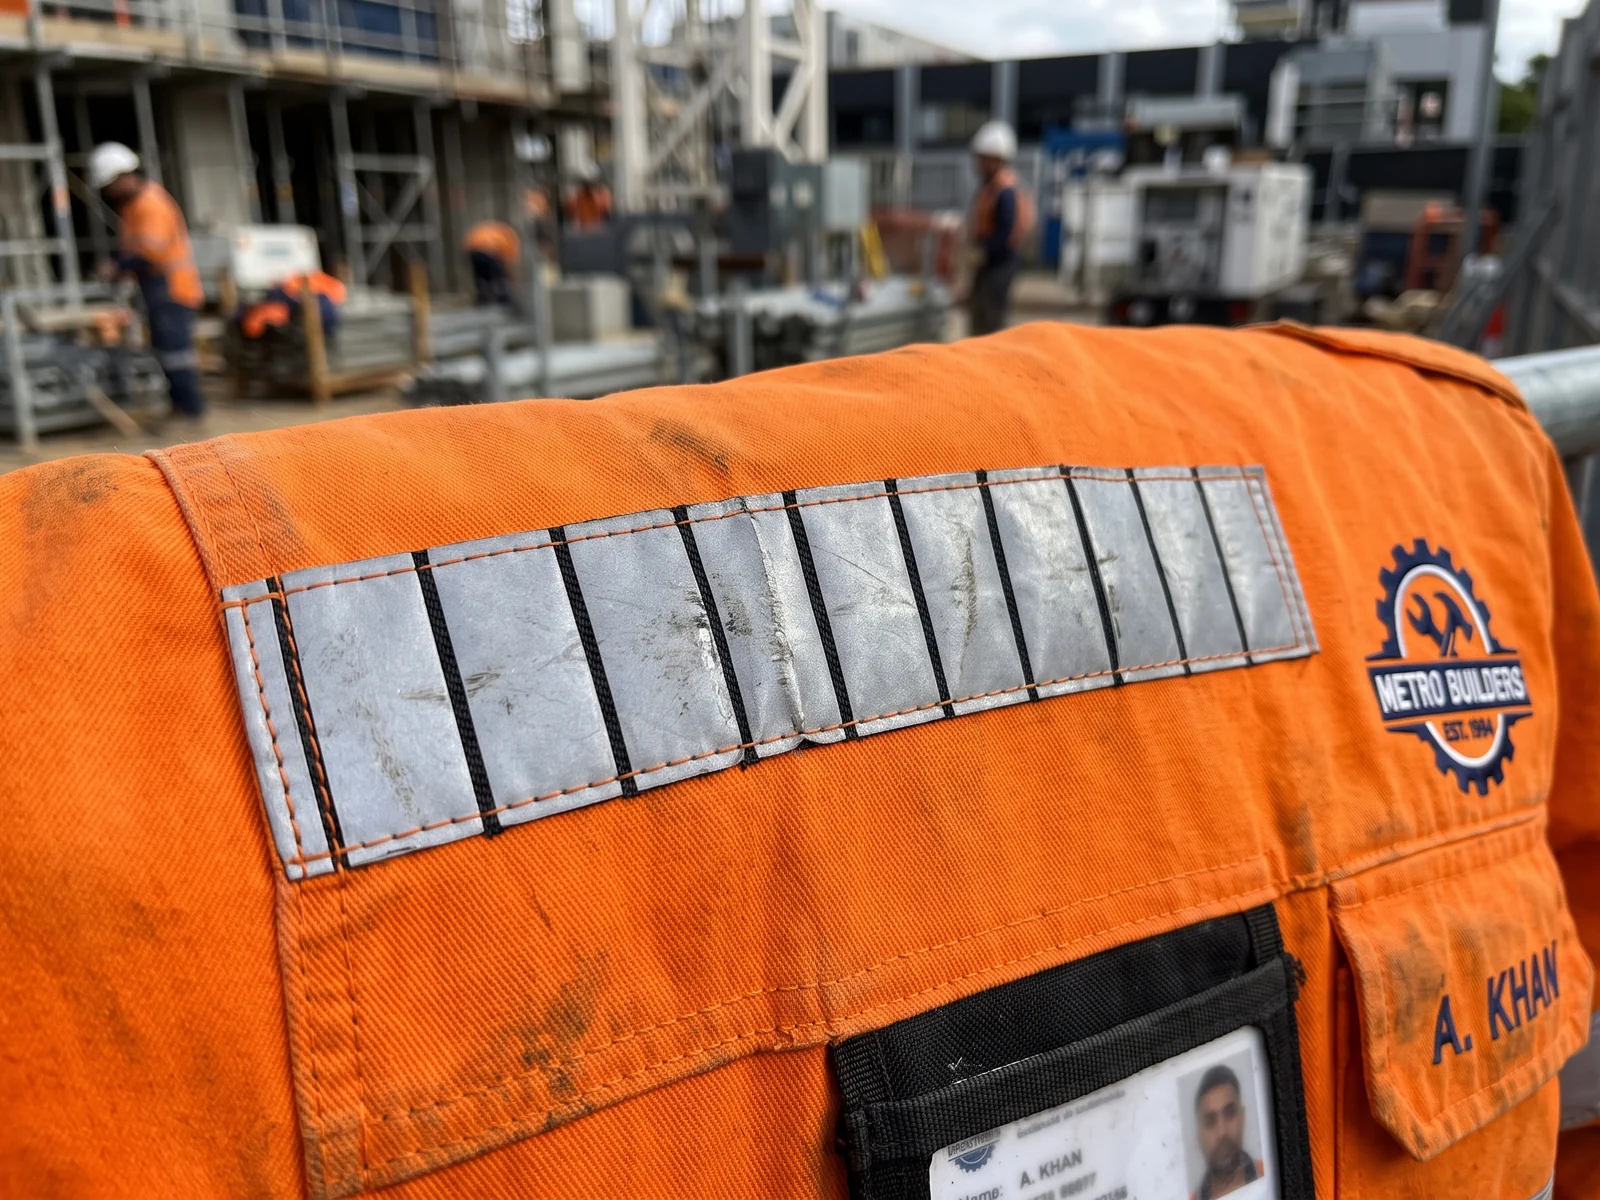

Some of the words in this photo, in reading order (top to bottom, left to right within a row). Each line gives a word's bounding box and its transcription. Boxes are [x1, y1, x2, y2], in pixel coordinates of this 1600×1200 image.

[1374, 669, 1446, 713] METRO
[1445, 666, 1526, 705] BUILDERS
[1442, 719, 1469, 741] EST.
[1432, 994, 1473, 1065] A.
[1487, 940, 1560, 1041] KHAN
[1020, 1170, 1035, 1189] A.
[1039, 1148, 1083, 1180] KHAN
